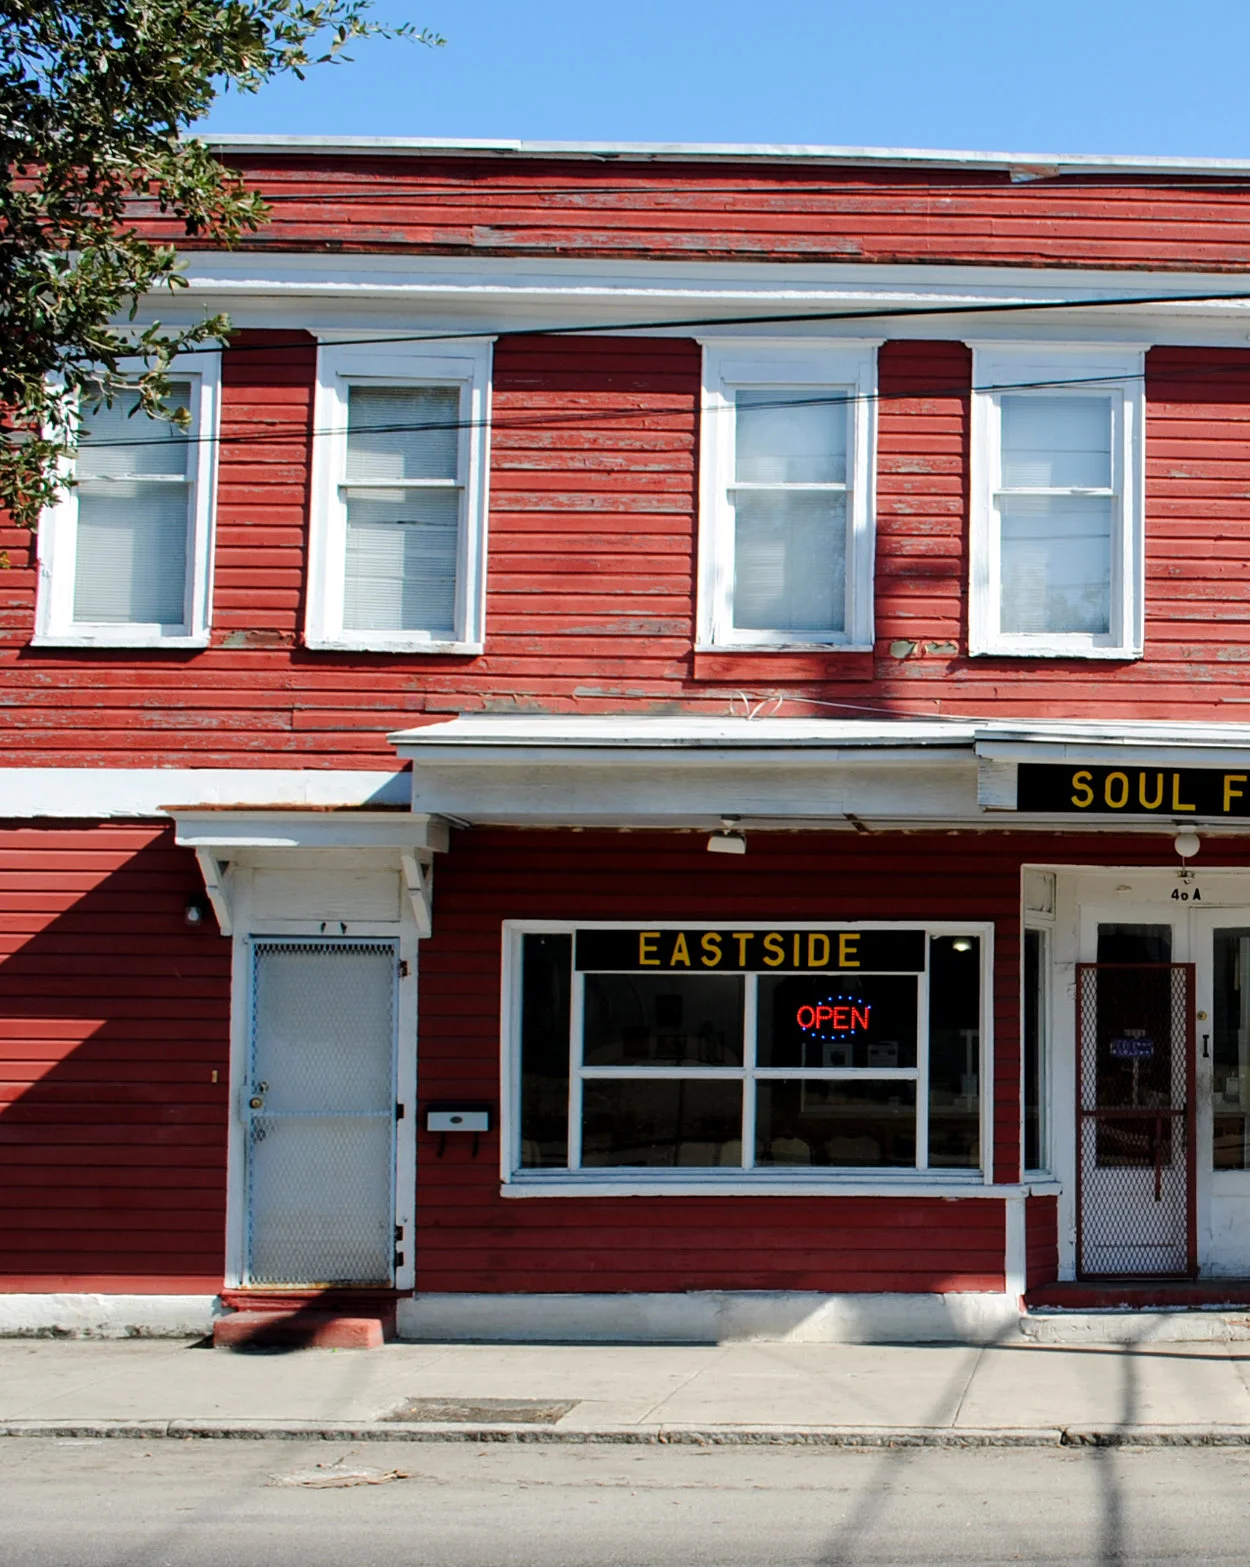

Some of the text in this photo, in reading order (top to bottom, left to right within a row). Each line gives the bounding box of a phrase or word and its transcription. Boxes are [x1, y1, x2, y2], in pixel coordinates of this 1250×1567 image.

[1070, 770, 1196, 811] SOUL
[638, 931, 861, 967] EASTSIDE
[796, 1005, 870, 1030] OPEN
